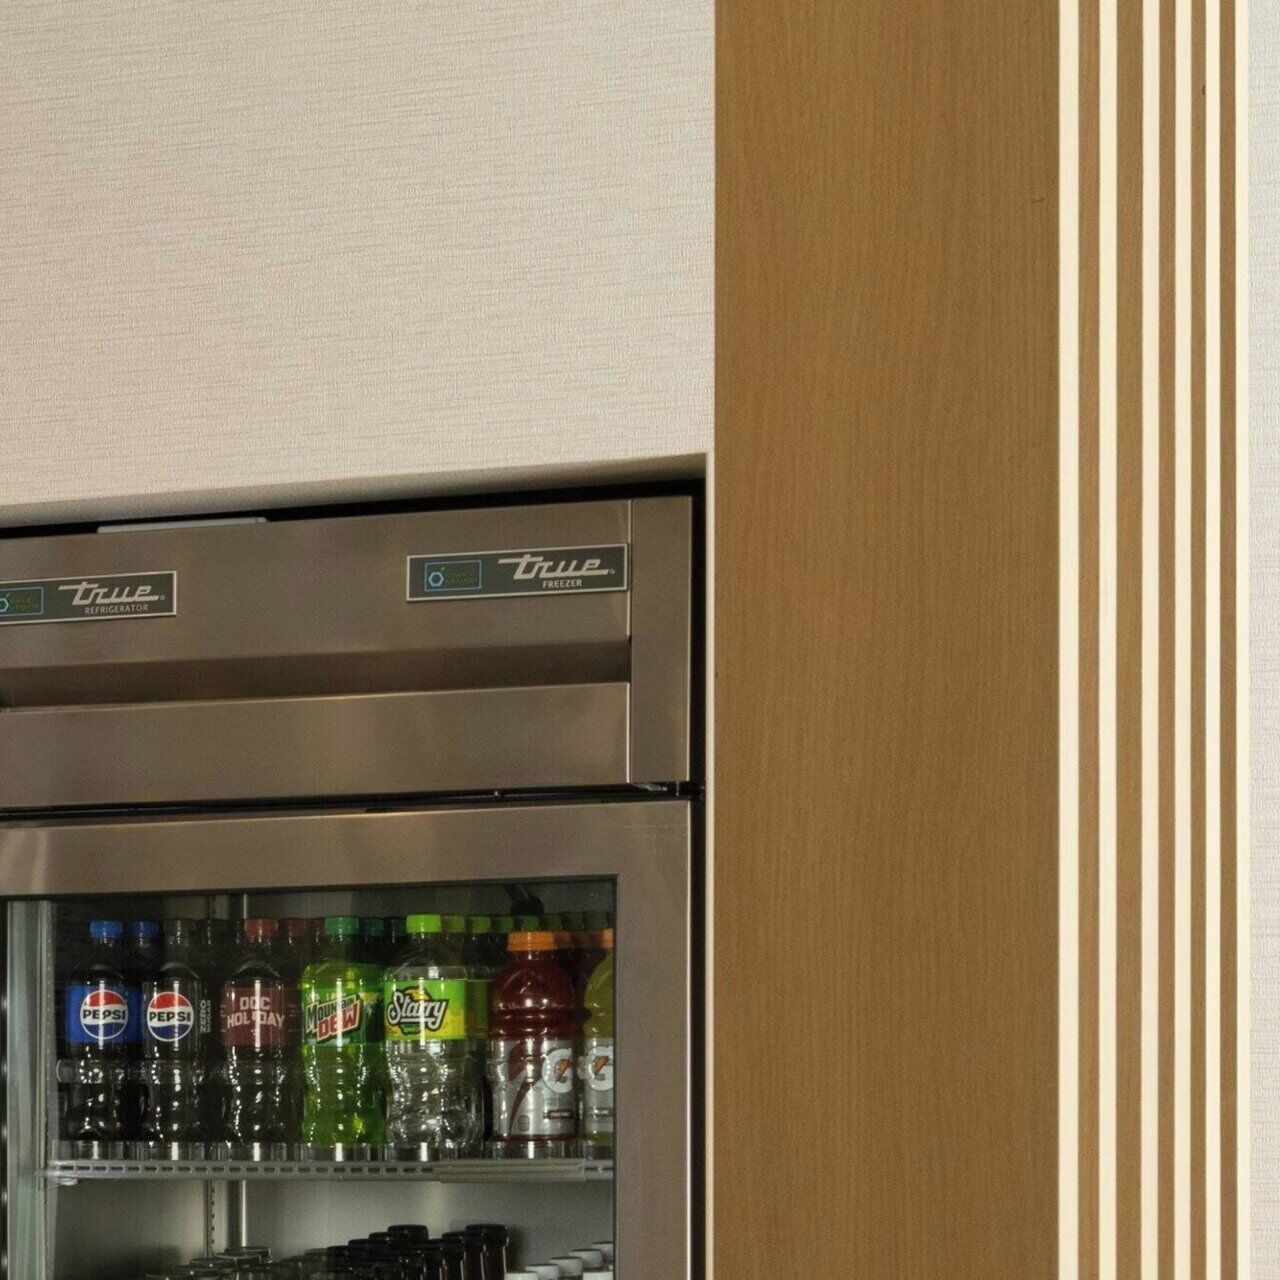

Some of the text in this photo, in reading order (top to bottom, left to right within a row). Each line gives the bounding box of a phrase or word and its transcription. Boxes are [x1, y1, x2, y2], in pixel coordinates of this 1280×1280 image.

[543, 579, 582, 588] FREEZER
[85, 604, 148, 615] REFRIGERATOR
[82, 1009, 126, 1020] PEPSI
[149, 1011, 192, 1022] PEPSI
[200, 1001, 208, 1033] ZERO
